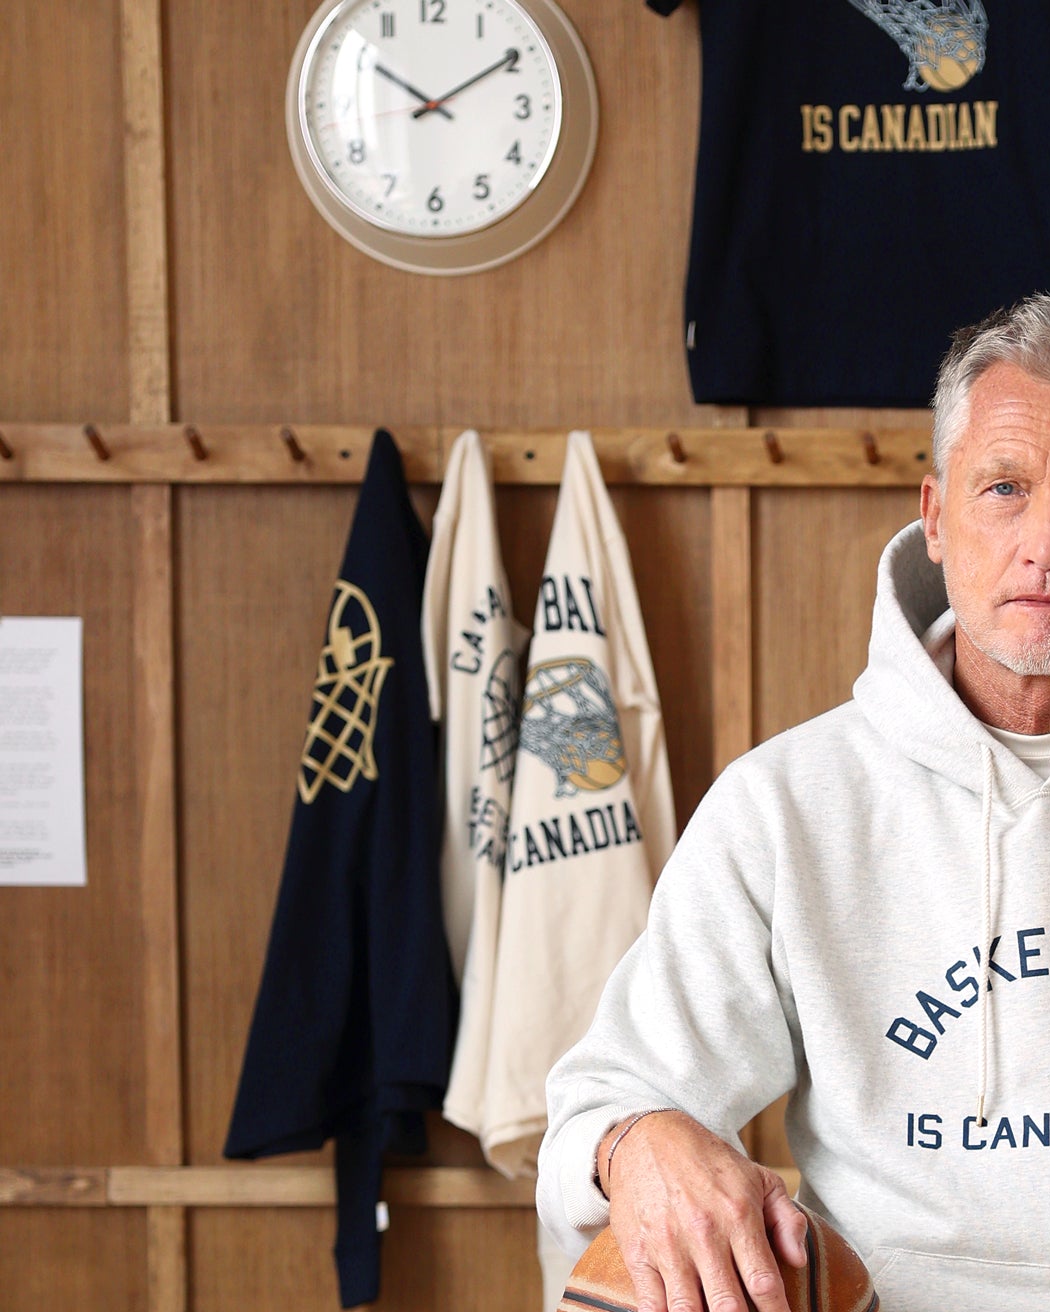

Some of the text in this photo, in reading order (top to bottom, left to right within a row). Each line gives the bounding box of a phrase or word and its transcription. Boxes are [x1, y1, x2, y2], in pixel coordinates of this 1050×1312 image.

[419, 0, 445, 23] 12
[381, 13, 395, 38] 11
[477, 13, 484, 39] 1
[515, 94, 531, 120] 3
[800, 101, 999, 153] IS CANADIAN
[349, 138, 366, 165] 8
[506, 140, 522, 165] 4
[382, 172, 397, 198] 7
[474, 174, 490, 200] 5
[428, 186, 444, 213] 6
[907, 1112, 943, 1151] IS
